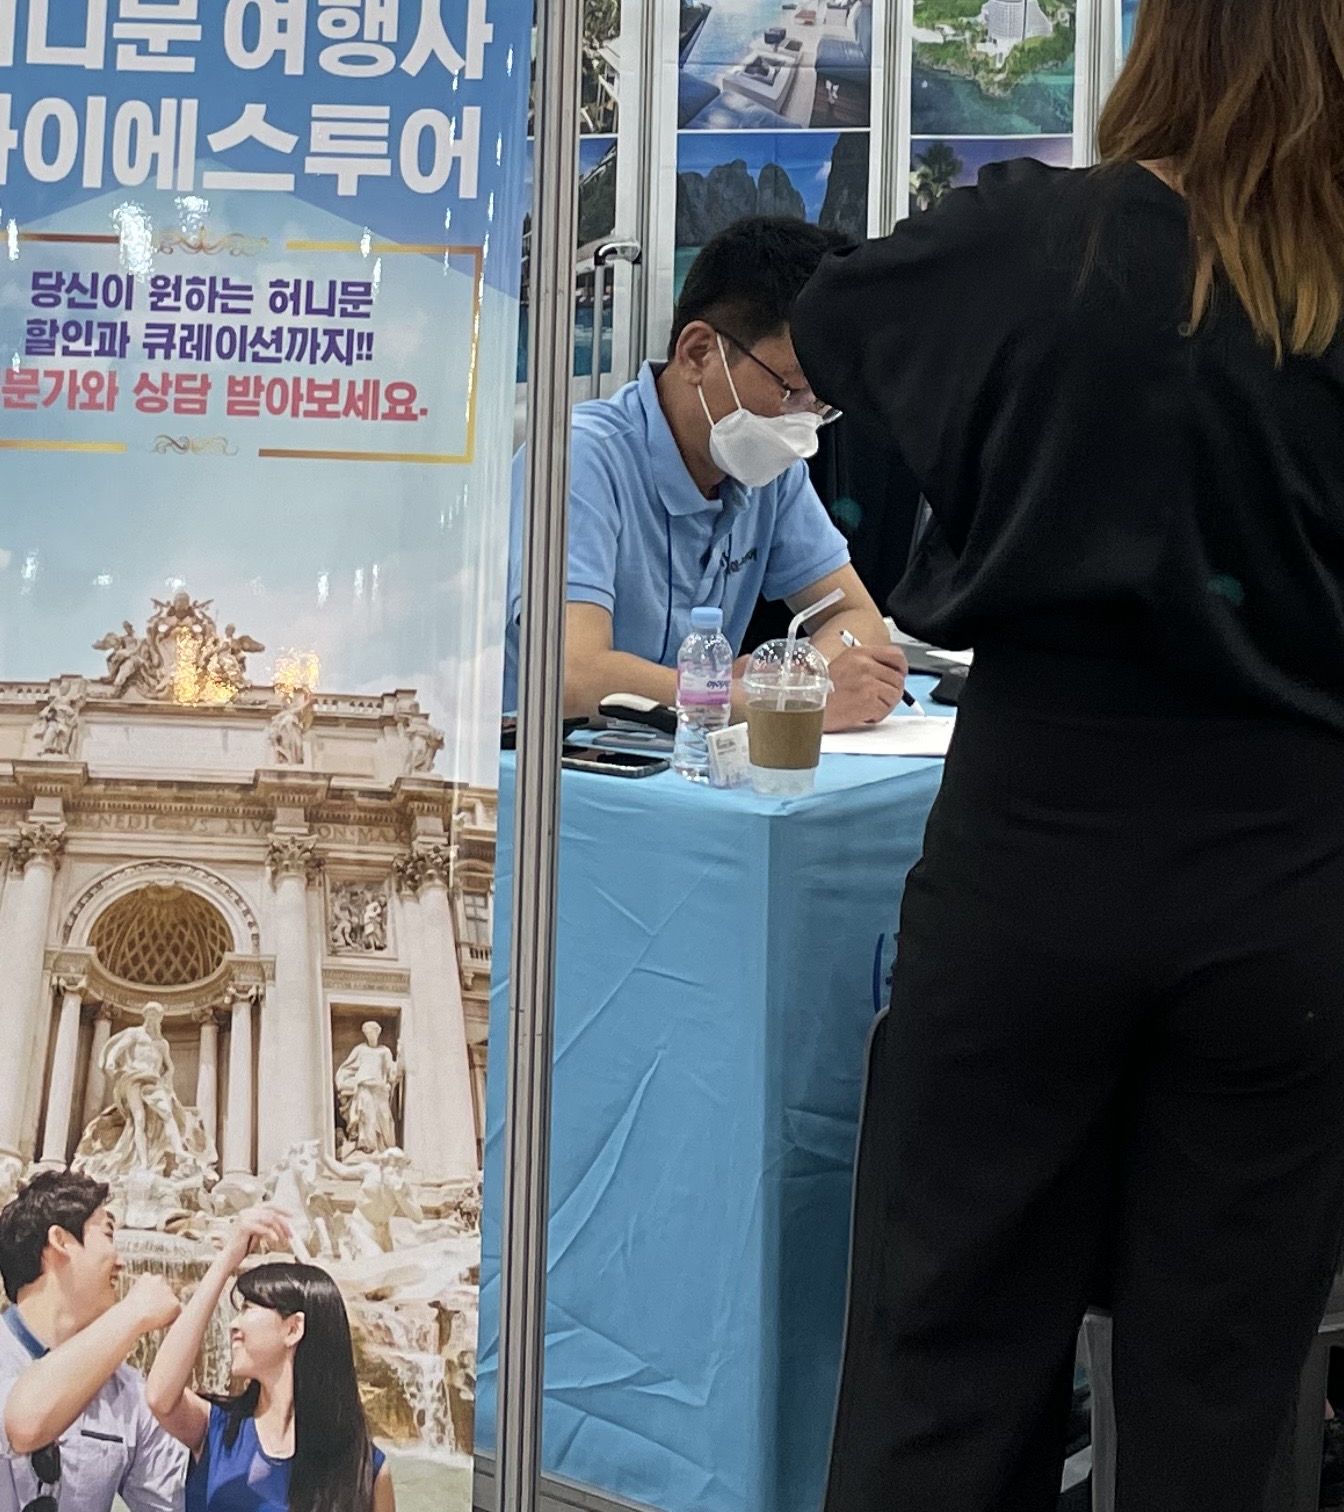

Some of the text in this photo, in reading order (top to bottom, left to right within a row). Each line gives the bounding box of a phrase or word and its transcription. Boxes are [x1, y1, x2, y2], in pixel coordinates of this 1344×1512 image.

[30, 270, 374, 319] 당신이 원하는 허니문
[24, 317, 374, 366] 할인과 큐레이션까지!!
[132, 372, 207, 418] 상담
[226, 375, 429, 425] 받아보세요.
